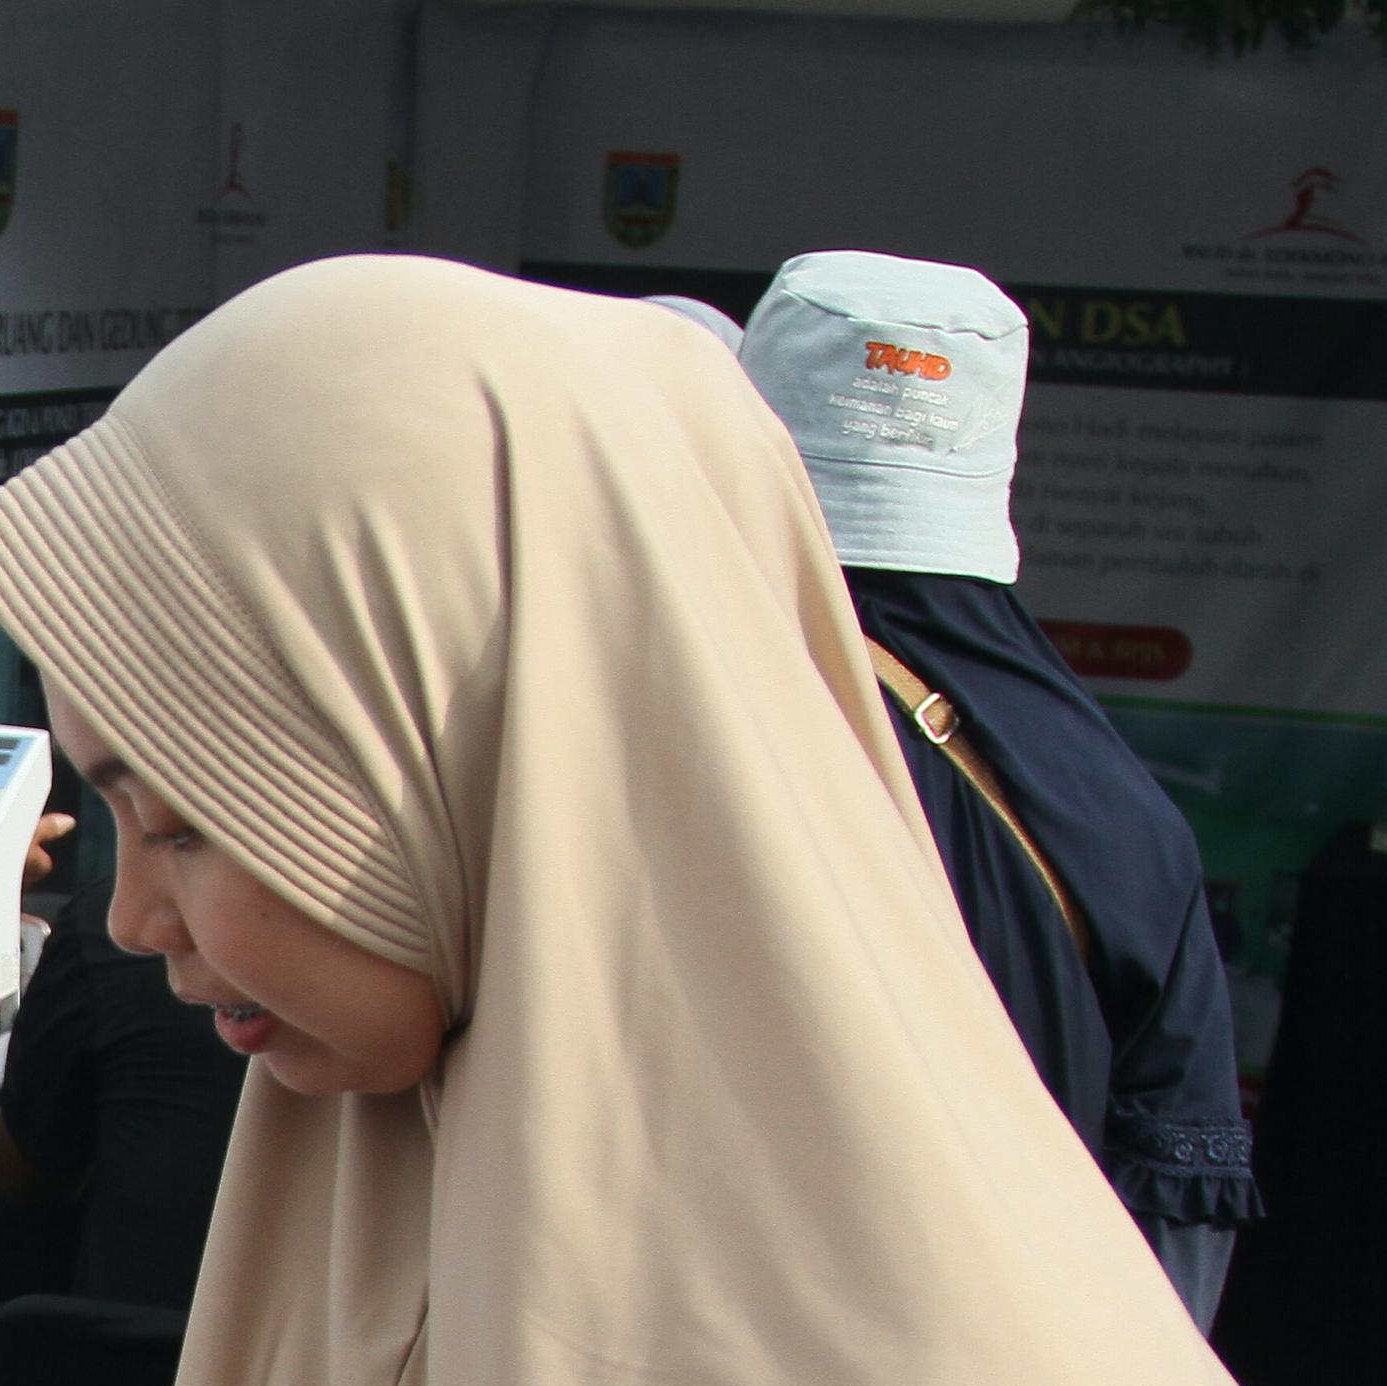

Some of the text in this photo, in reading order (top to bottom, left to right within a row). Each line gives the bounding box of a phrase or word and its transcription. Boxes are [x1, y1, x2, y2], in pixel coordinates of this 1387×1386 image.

[59, 310, 96, 352] DAN
[1079, 299, 1188, 346] DSA
[852, 376, 900, 396] adalah
[841, 420, 879, 440] yang
